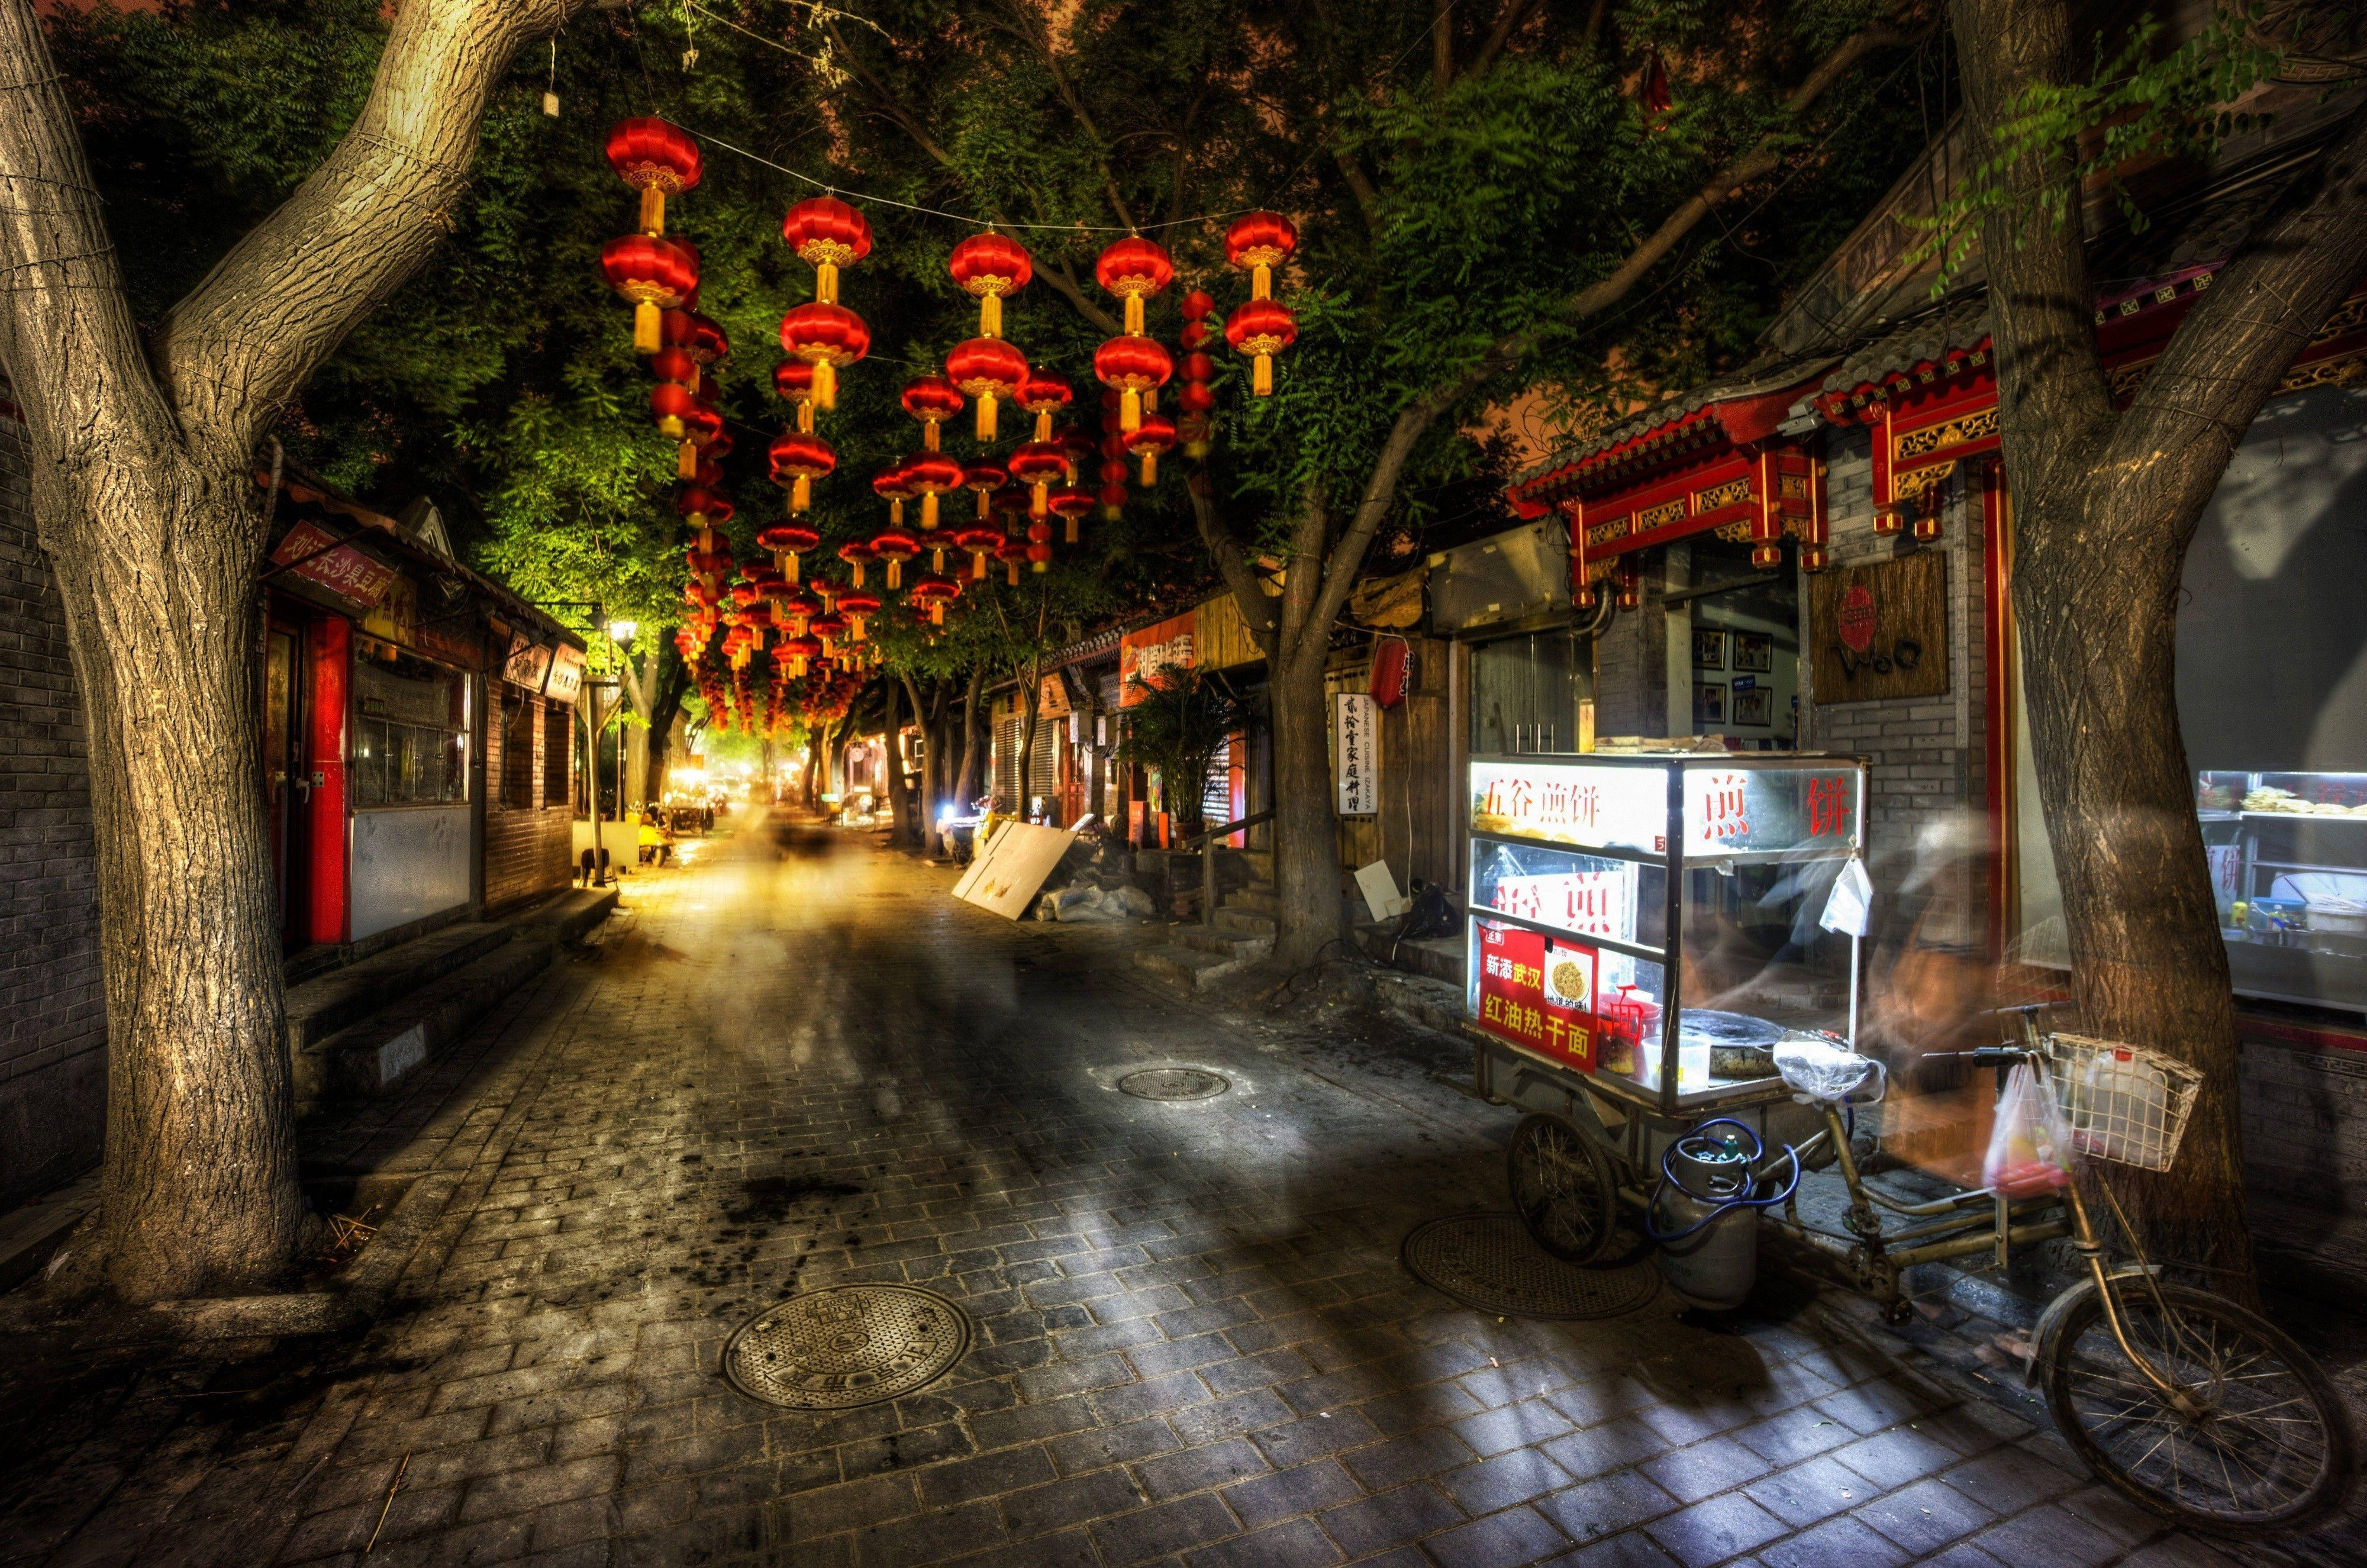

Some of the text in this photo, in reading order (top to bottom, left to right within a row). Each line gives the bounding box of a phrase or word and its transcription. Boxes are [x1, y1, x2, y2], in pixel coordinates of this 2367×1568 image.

[1484, 779, 1600, 828] 五谷煎饼
[1486, 953, 1542, 991] 新添武汉
[1485, 993, 1589, 1059] 红油热干面
